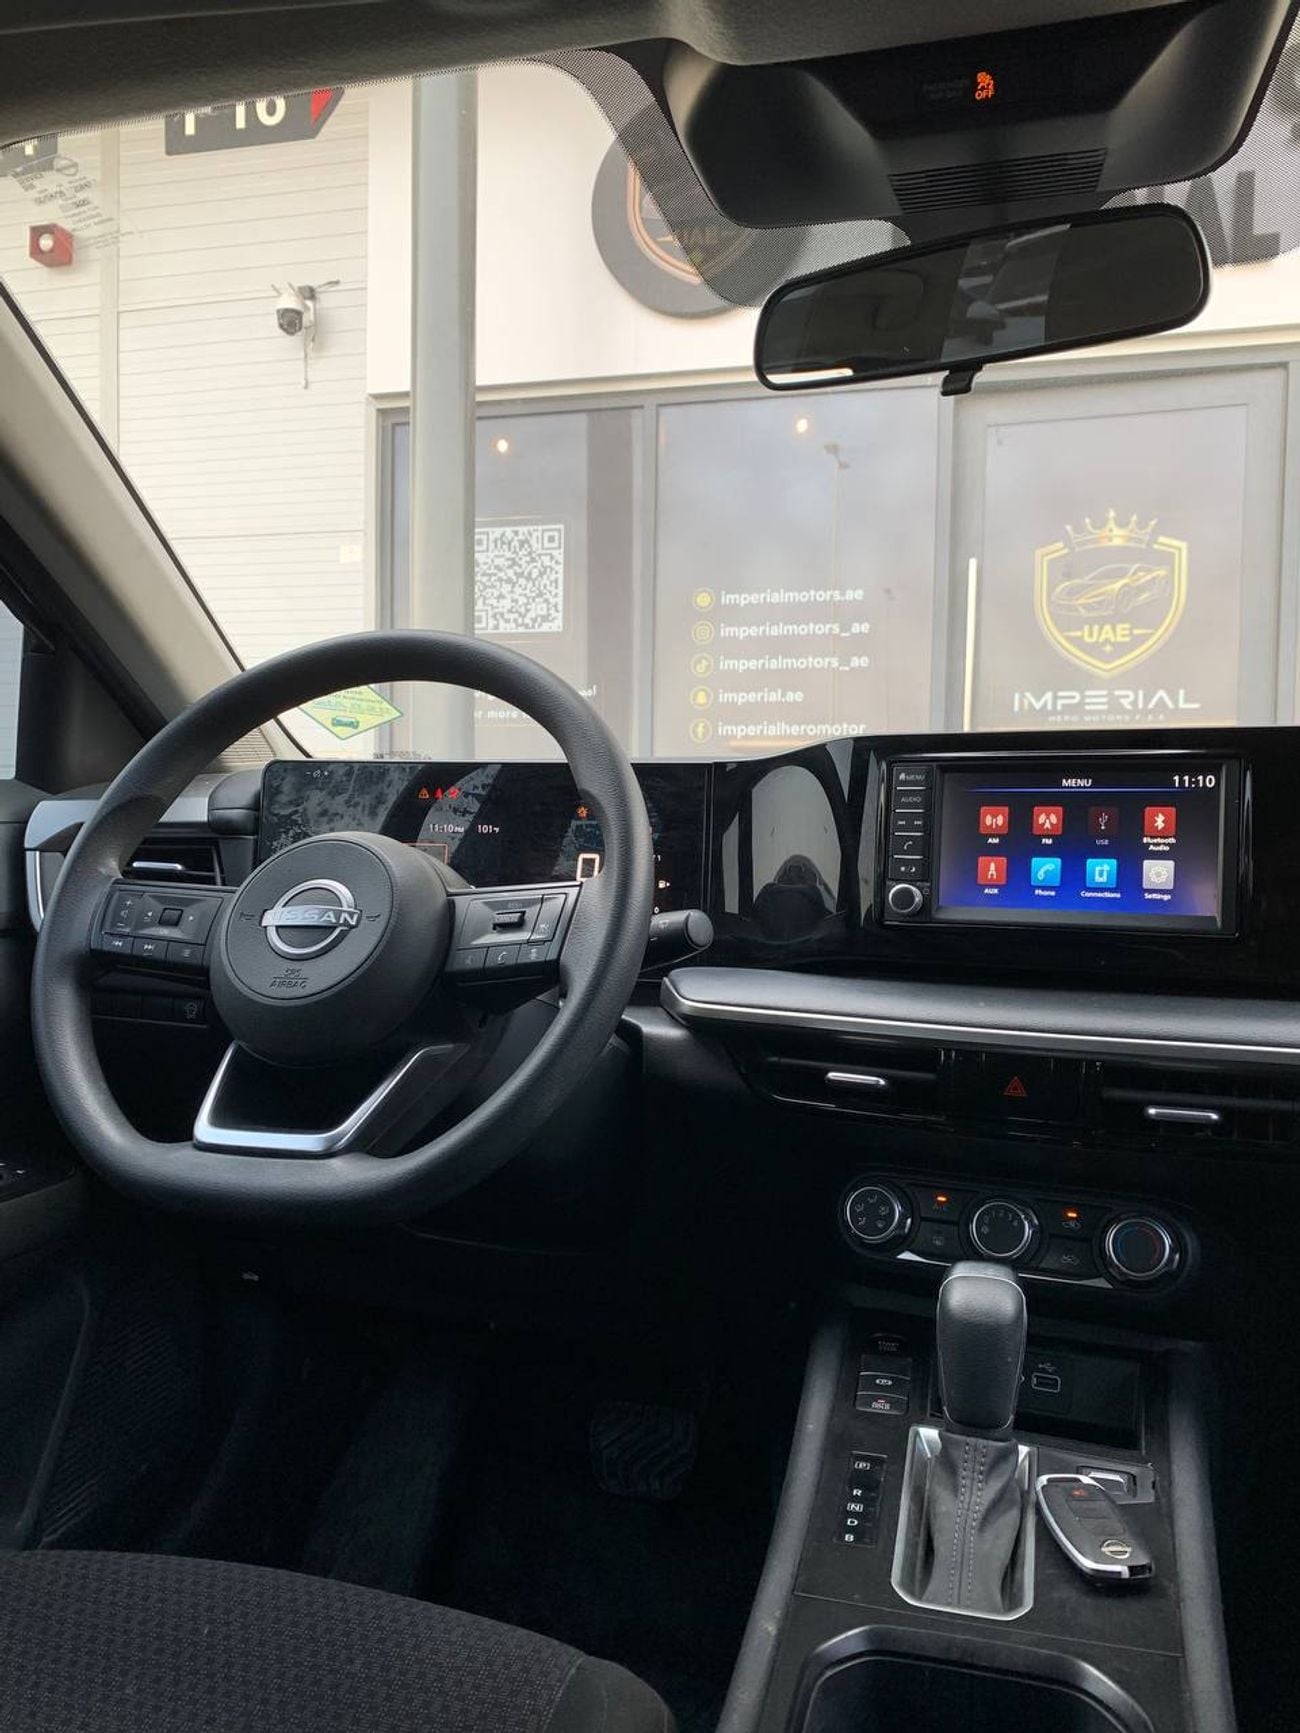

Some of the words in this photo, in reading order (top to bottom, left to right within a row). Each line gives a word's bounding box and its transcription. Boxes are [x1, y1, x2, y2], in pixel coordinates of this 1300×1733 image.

[975, 89, 995, 100] OFF
[720, 588, 865, 606] imperialmotors.ae
[719, 621, 870, 639] imperialmotors_ae
[1082, 623, 1132, 643] UAE
[718, 655, 869, 672] imperialmotors_ae
[718, 687, 804, 705] imperial.ae
[1013, 688, 1201, 712] IMPERIAL
[717, 720, 867, 738] imperialheromotor
[1061, 778, 1093, 787] MENU
[1172, 775, 1216, 788] 11:10
[1080, 890, 1121, 898] Connections
[1143, 892, 1172, 901] Settings
[264, 908, 360, 926] ISSAN
[852, 1488, 863, 1497] R
[846, 1518, 859, 1526] D
